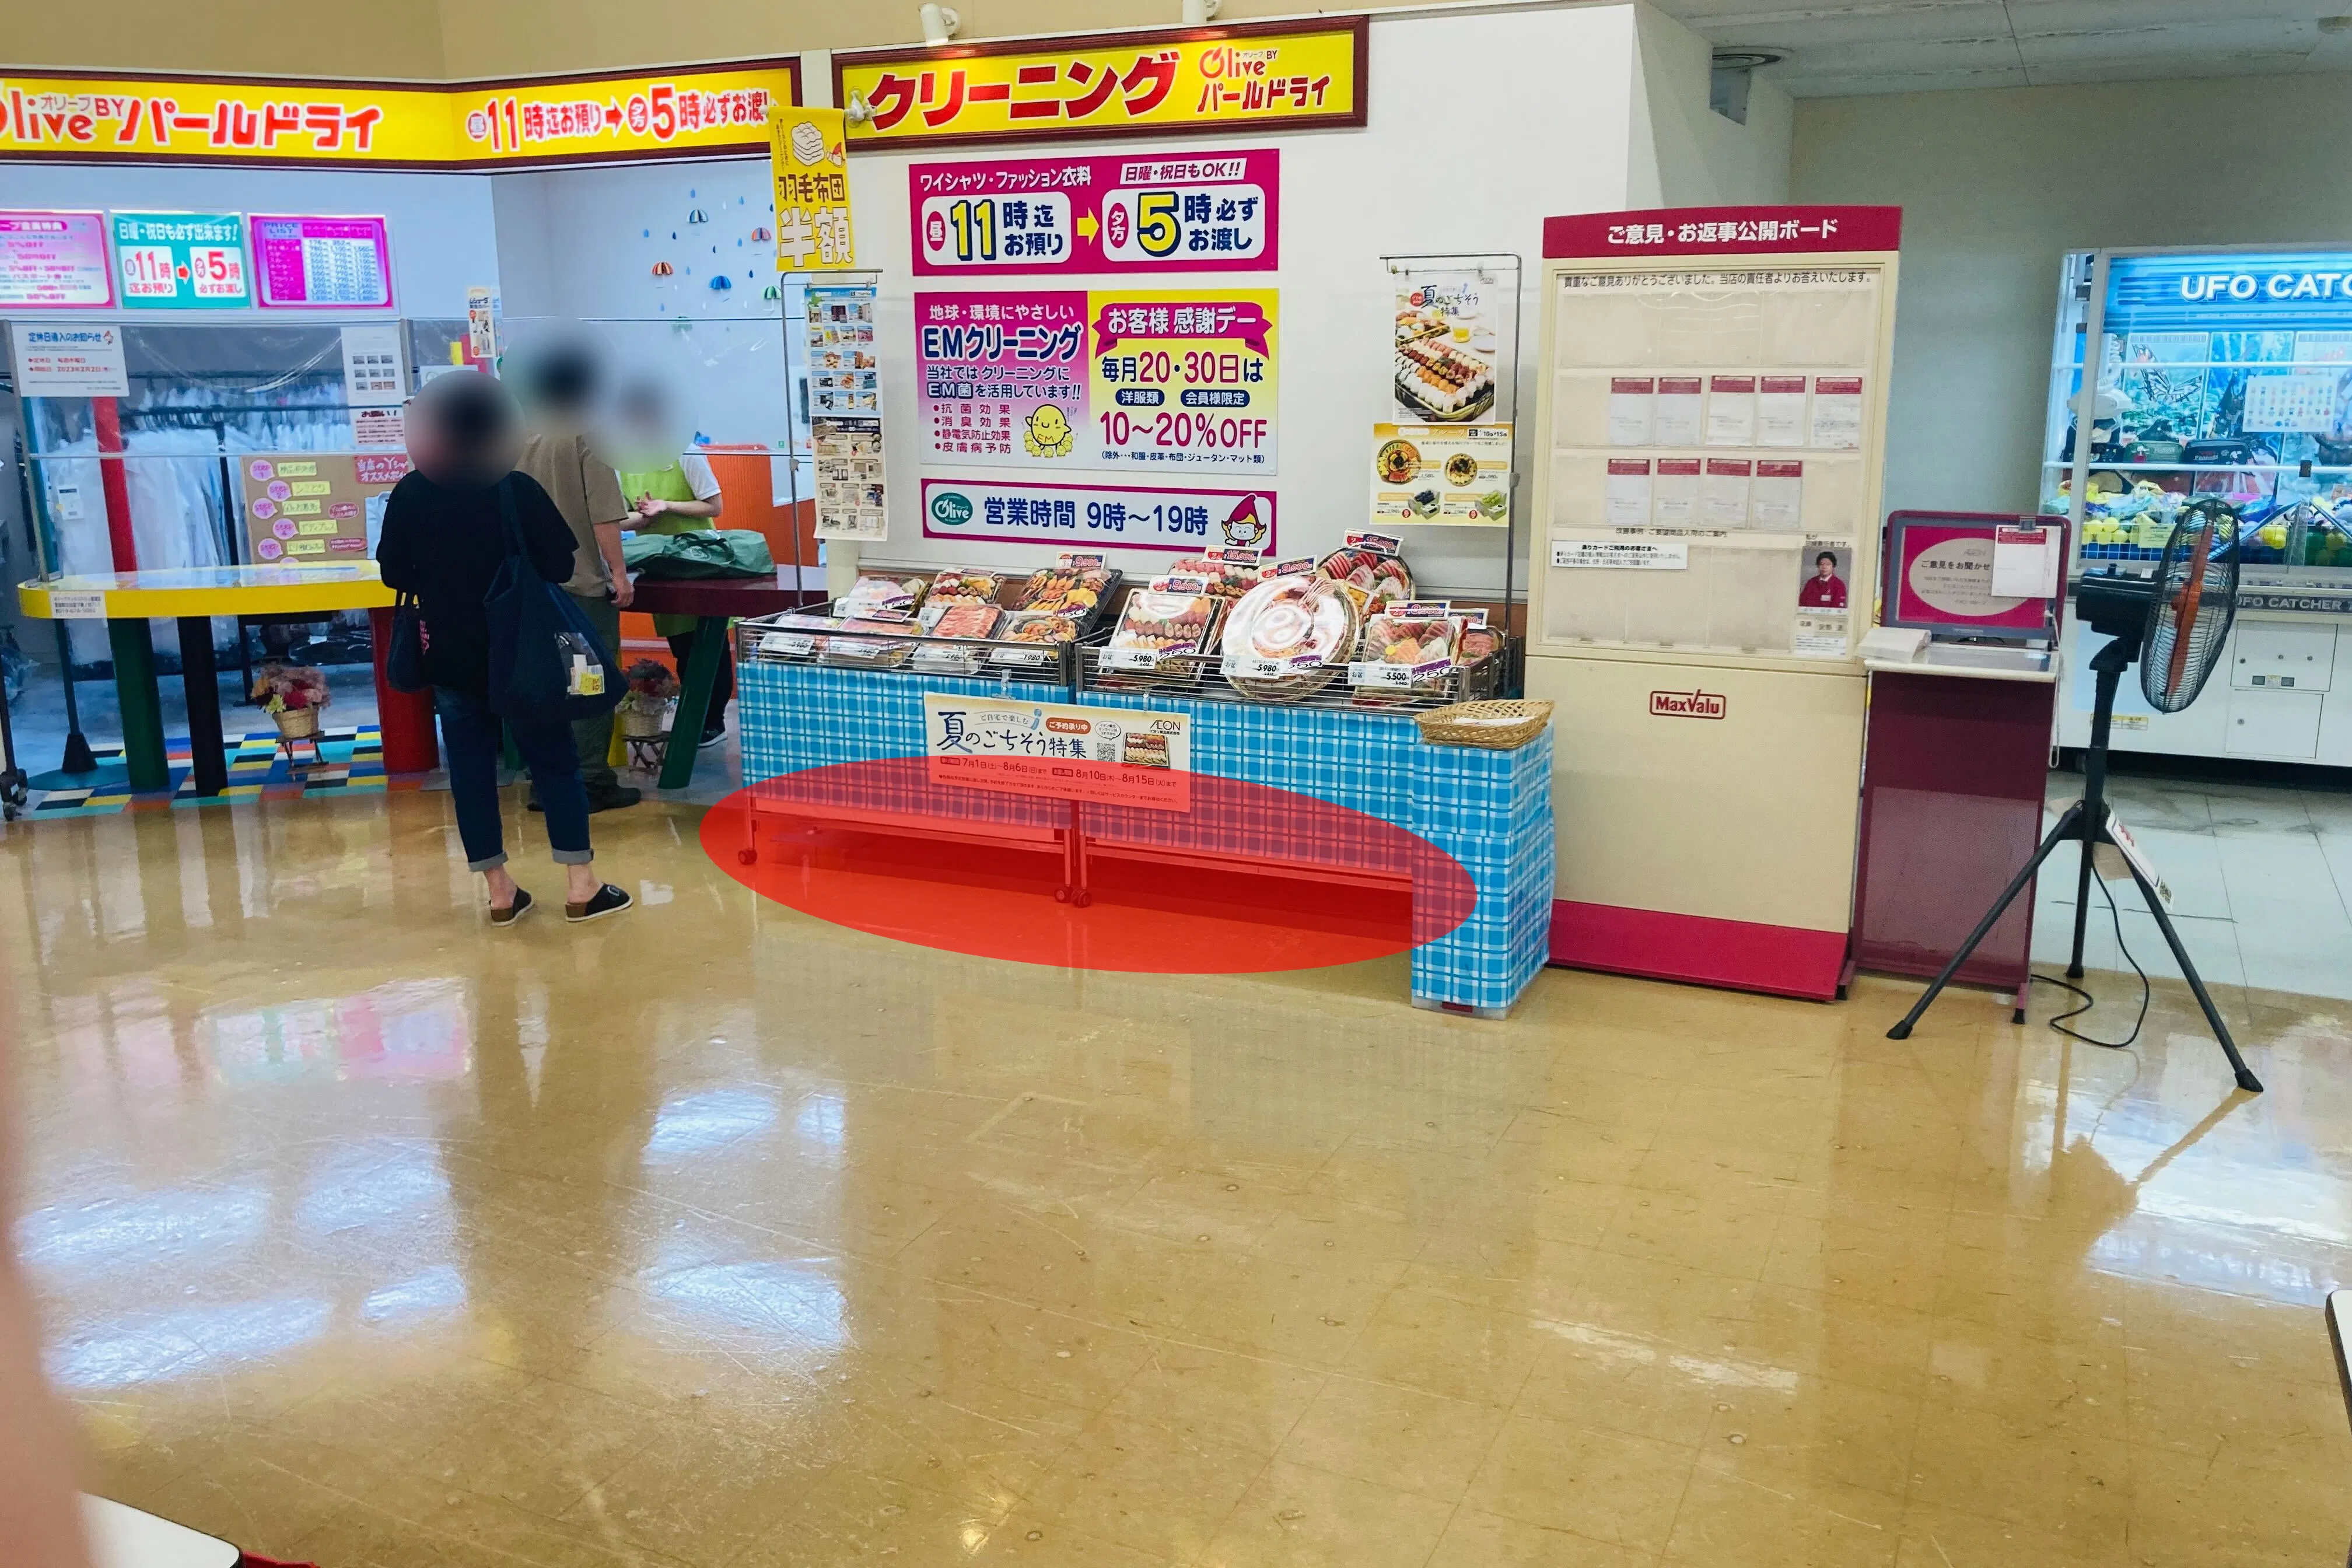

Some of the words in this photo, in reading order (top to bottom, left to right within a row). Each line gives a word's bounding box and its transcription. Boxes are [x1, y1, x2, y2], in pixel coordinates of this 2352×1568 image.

[1199, 47, 1265, 78] Olive
[1266, 50, 1278, 60] BY
[867, 51, 1180, 131] クリーニング
[1197, 75, 1330, 112] パールドライ
[0, 90, 96, 140] live
[96, 97, 124, 117] BY
[118, 99, 381, 149] パールドライ
[778, 172, 845, 204] 羽毛布団
[779, 206, 853, 267] 半額
[929, 219, 943, 242] 昼
[1111, 211, 1128, 240] 夕方
[1608, 219, 1838, 244] ご意見・お返事公開ボード
[1421, 285, 1479, 309] 夏のごちそう
[2181, 275, 2259, 300] UFO
[929, 304, 1074, 321] 地球・環境にやさしい
[1440, 306, 1460, 317] 特集
[924, 324, 1082, 360] EMクリーニング
[1121, 391, 1159, 404] 洋服類
[1185, 392, 1245, 405] 会員様限定
[942, 429, 1011, 441] 静電気防止効果
[1037, 433, 1054, 443] EM
[935, 499, 970, 519] Olive
[984, 496, 1075, 528] 営業時間
[2269, 597, 2342, 610] CATCHER
[1656, 689, 1720, 714] MaxValu
